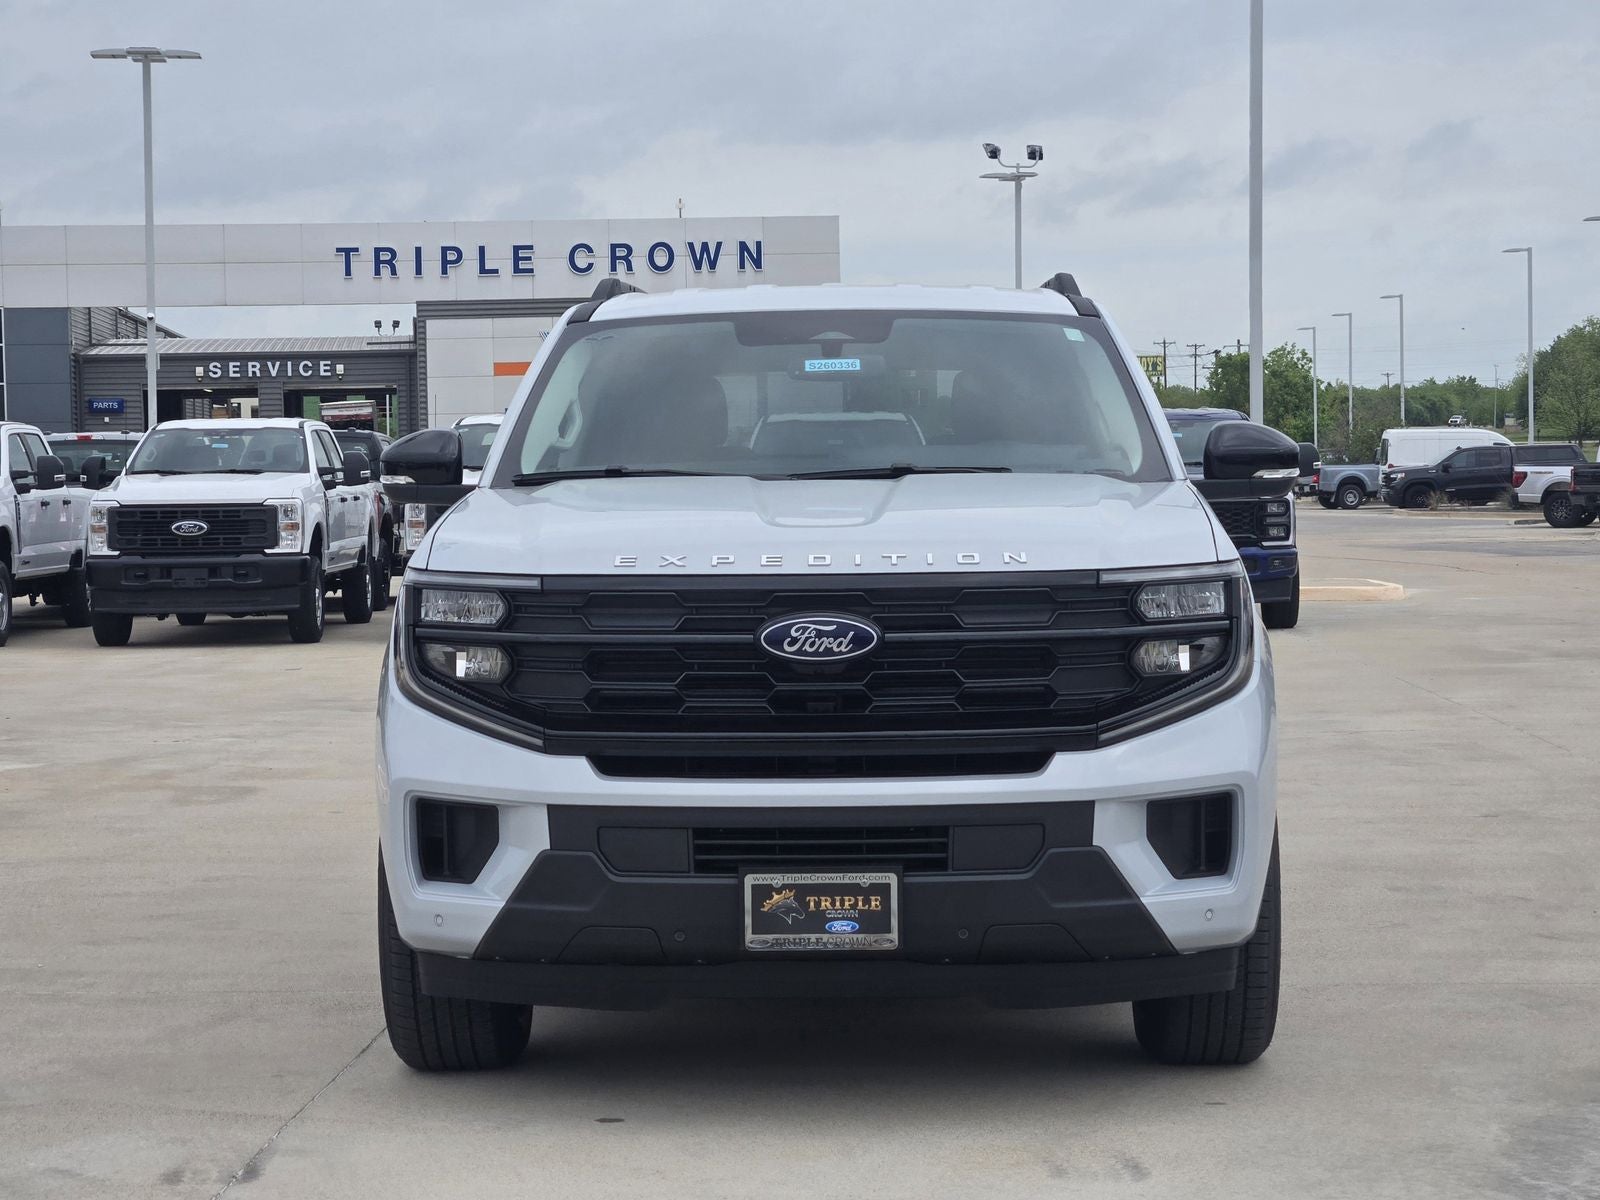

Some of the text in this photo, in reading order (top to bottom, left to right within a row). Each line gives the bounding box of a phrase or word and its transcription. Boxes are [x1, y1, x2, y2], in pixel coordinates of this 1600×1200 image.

[335, 239, 764, 279] TRIPLE CROWN
[208, 360, 332, 378] SERVICE
[808, 361, 857, 370] S260336
[613, 551, 1029, 568] EXPEDITION
[783, 624, 855, 653] Ford
[806, 896, 882, 911] TRIPLE
[825, 910, 859, 918] CROWN
[771, 936, 824, 949] TRIPLE
[826, 936, 872, 949] CROWN
